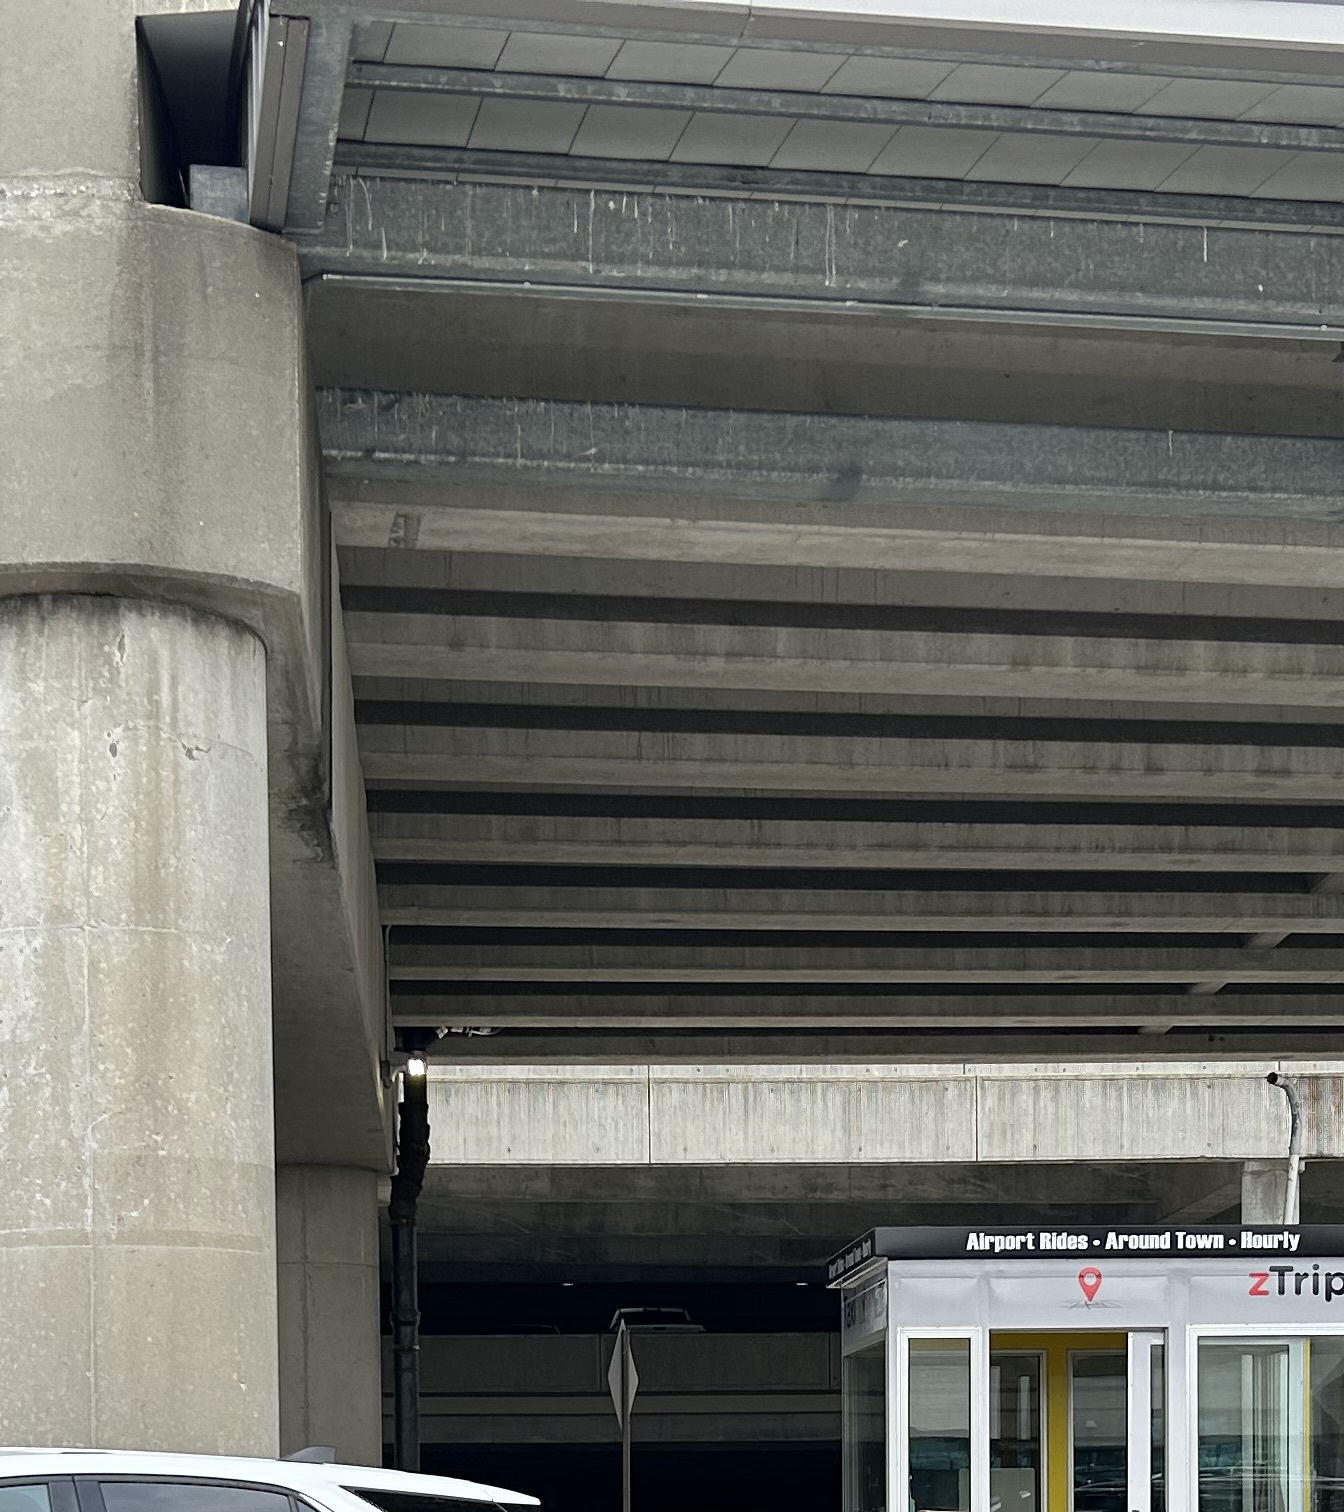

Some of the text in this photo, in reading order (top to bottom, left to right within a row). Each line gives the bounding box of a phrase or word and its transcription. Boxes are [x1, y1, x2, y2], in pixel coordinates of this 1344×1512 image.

[966, 1231, 1300, 1252] Airport Rides Around Town Hourly
